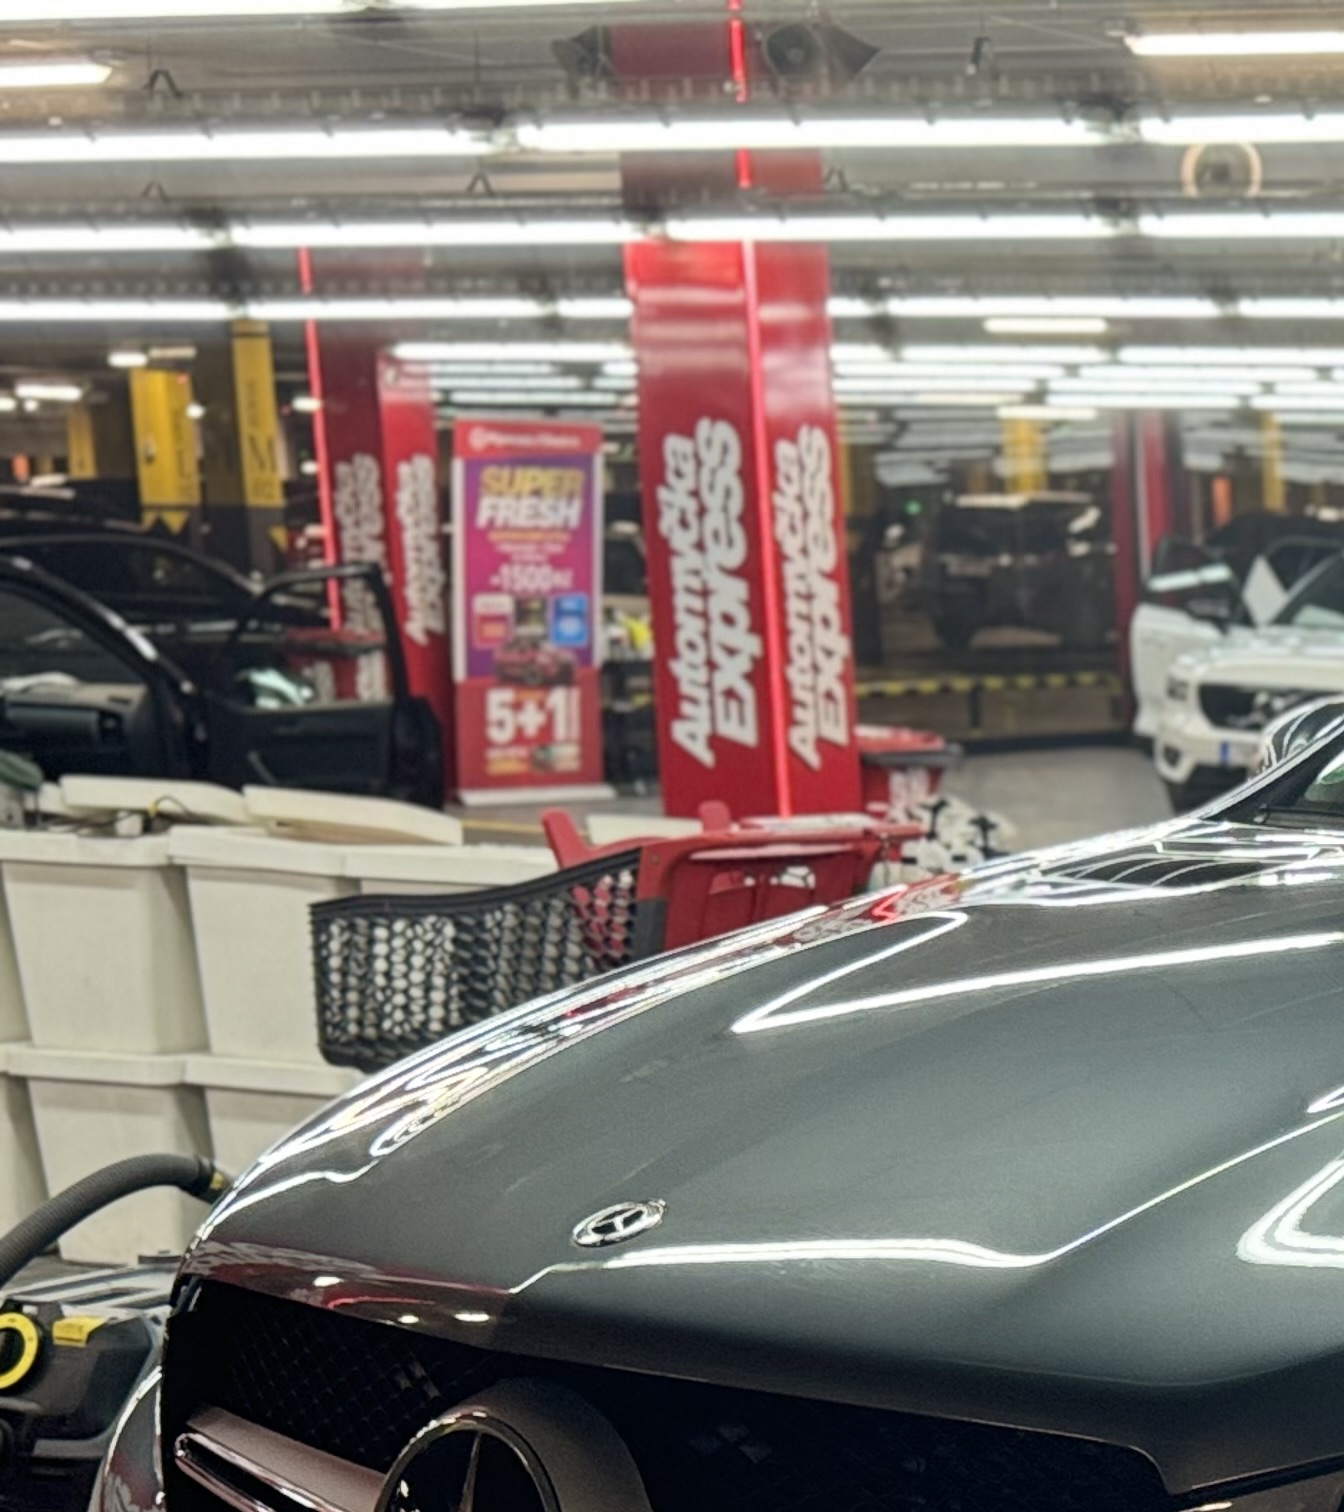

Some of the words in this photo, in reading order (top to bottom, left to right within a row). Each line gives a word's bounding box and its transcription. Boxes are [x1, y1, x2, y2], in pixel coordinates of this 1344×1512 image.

[475, 496, 583, 529] FRESH
[480, 466, 585, 498] SUPER
[656, 433, 715, 768] Automyčka
[695, 416, 763, 747] Express
[773, 439, 821, 771] Automyčka
[797, 423, 850, 746] Express
